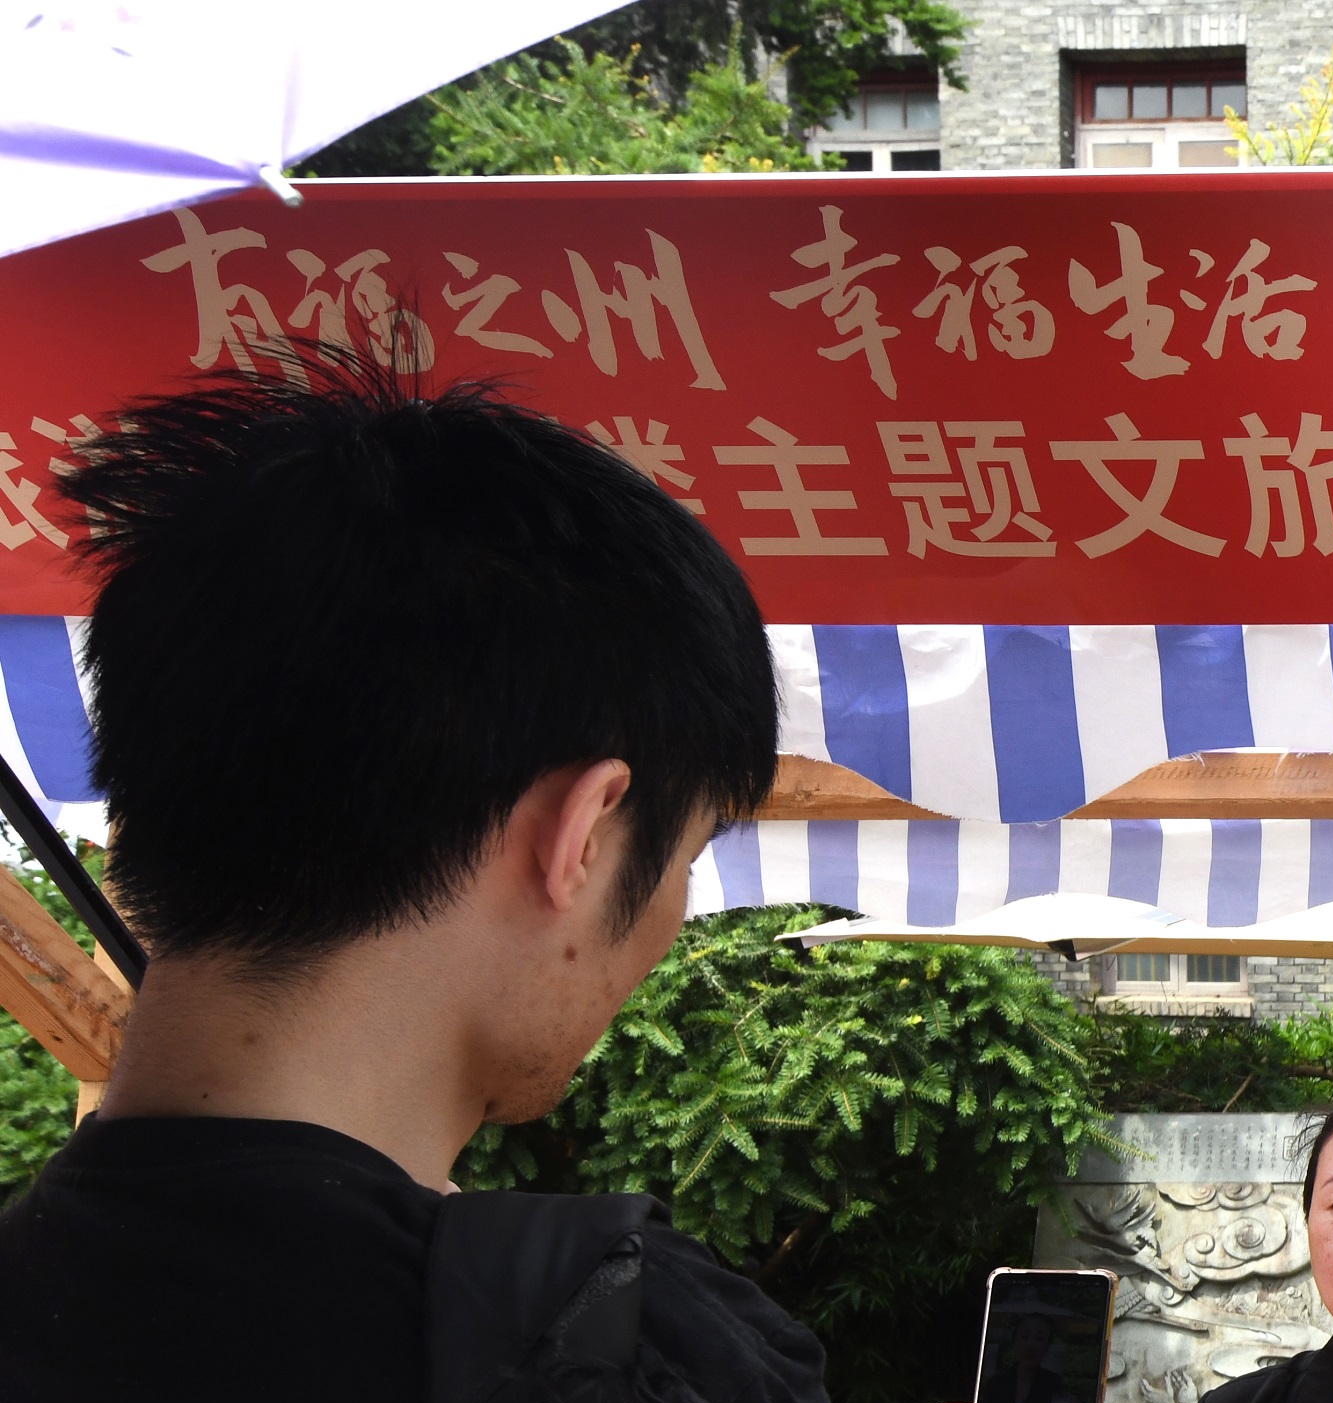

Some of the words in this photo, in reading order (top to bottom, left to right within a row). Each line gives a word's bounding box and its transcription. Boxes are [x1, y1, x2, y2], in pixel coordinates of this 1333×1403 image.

[140, 206, 727, 394] 有福之州
[768, 206, 1318, 399] 幸福生活
